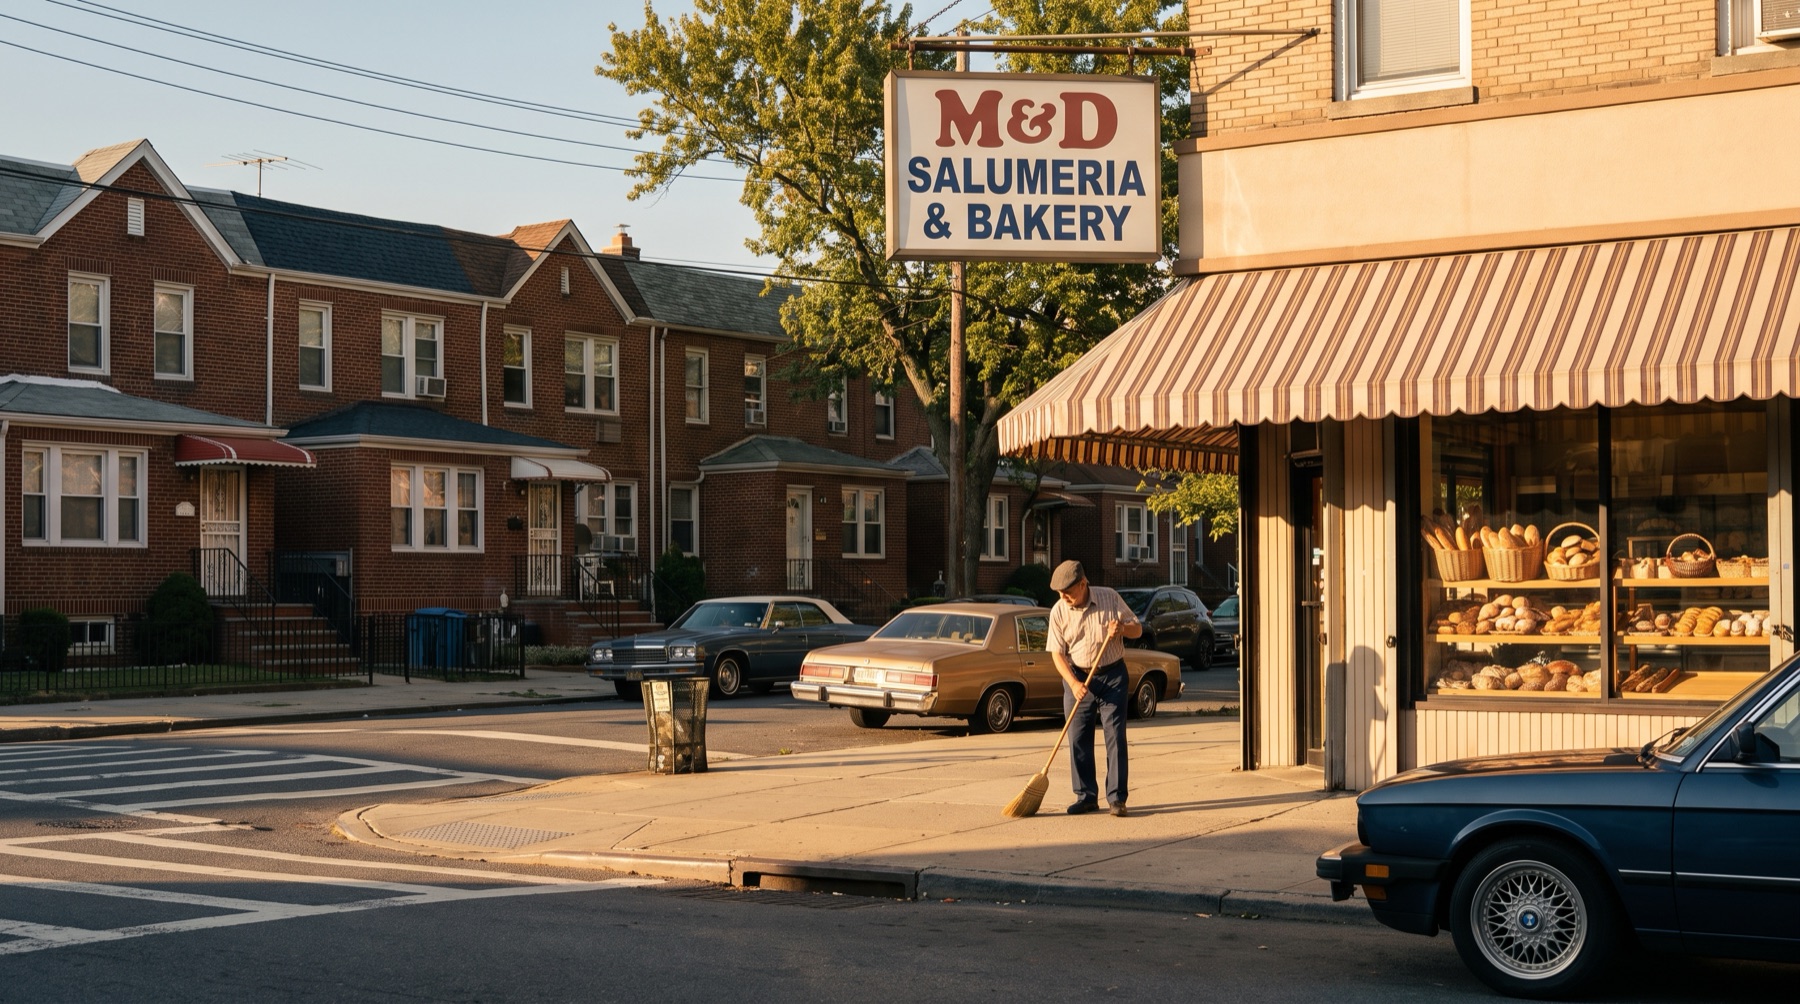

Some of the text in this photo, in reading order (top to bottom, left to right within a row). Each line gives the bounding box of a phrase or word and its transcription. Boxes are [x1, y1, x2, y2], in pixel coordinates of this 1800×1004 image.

[935, 90, 1117, 149] M&D
[908, 157, 1146, 196] SALUMERIA
[924, 203, 1131, 241] & BAKERY
